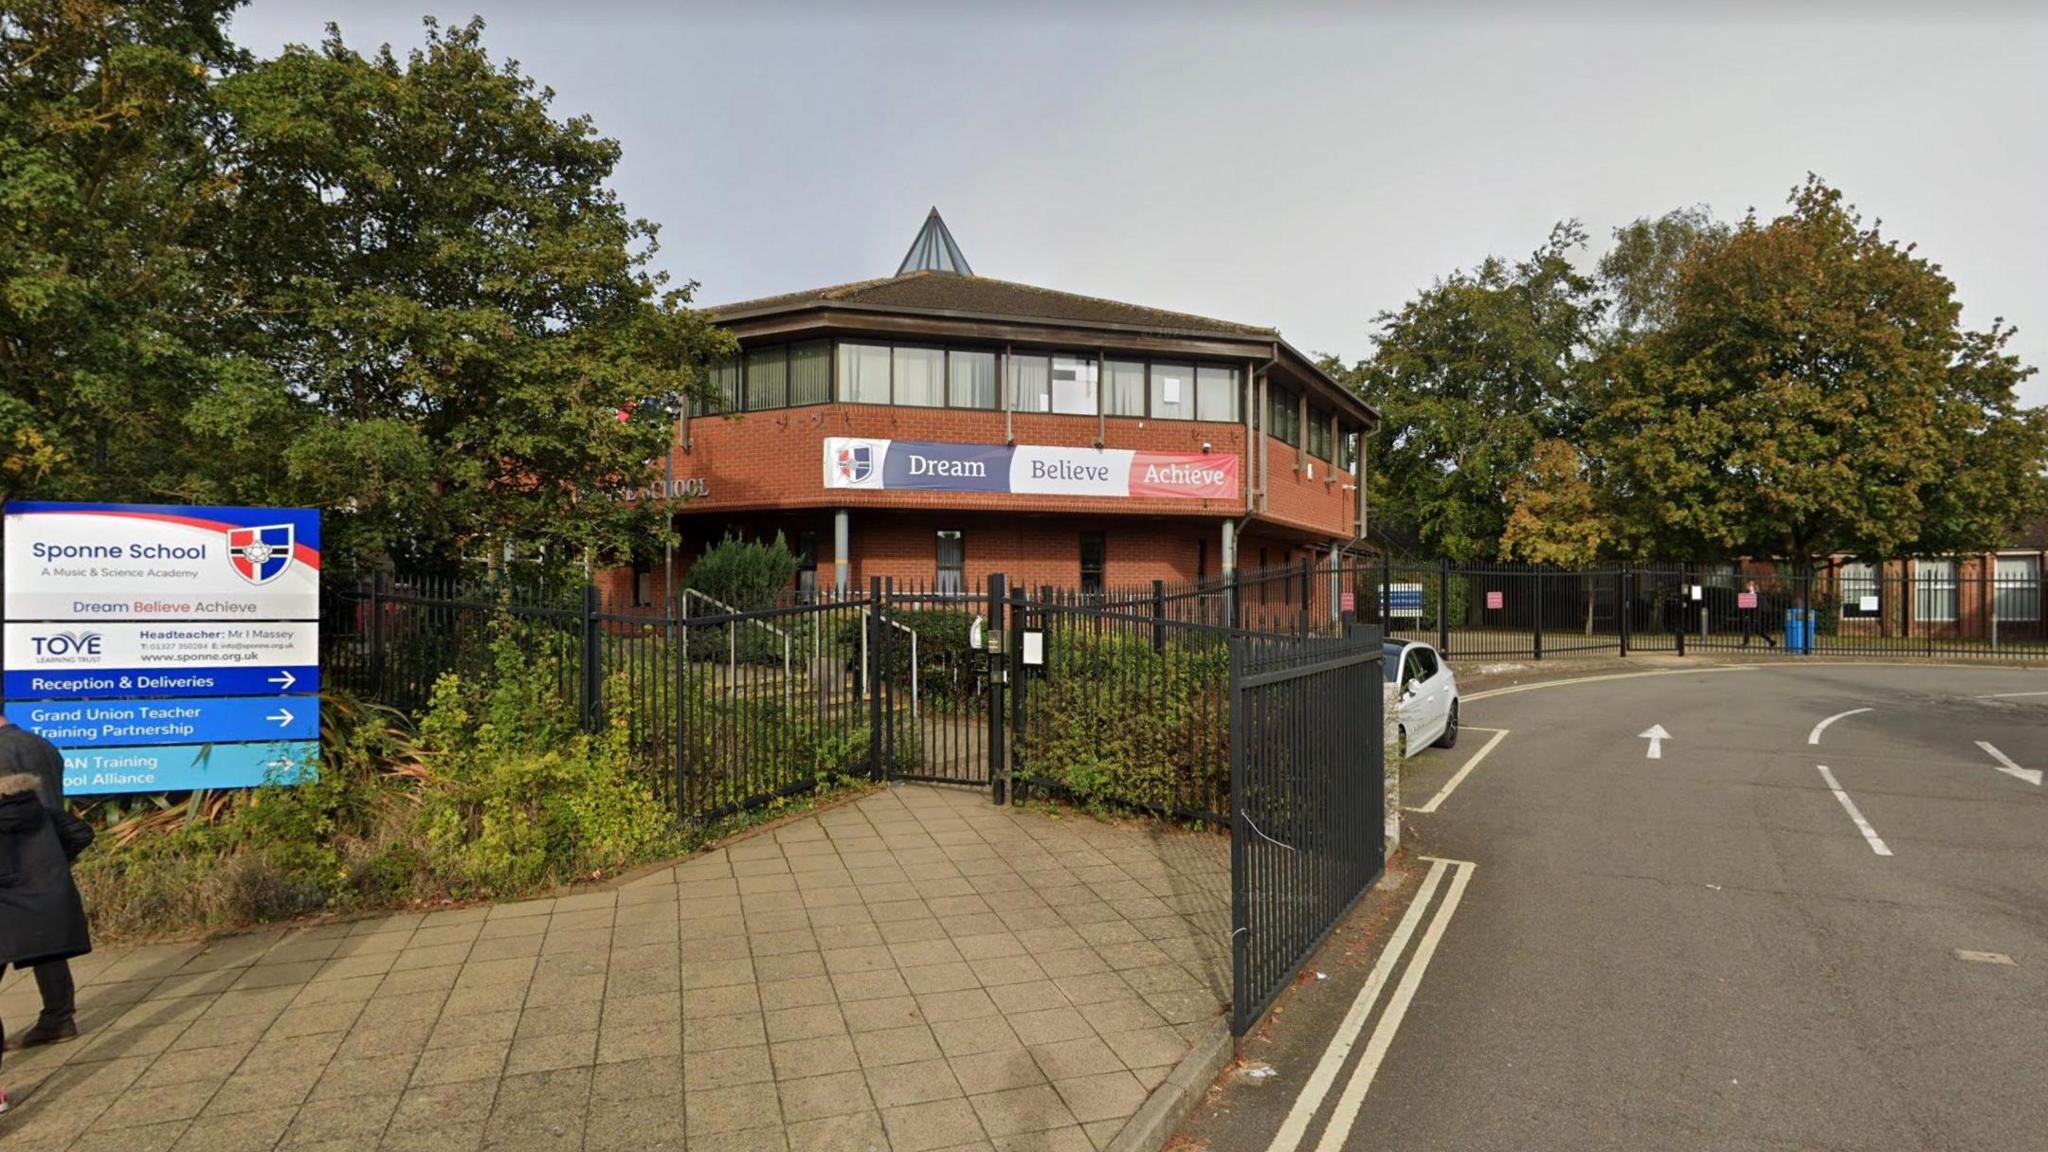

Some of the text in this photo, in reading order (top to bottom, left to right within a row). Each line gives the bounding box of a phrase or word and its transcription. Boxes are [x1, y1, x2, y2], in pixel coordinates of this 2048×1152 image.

[909, 454, 1225, 485] Dream Believe Achieve
[32, 542, 206, 563] Sponne School
[41, 567, 199, 579] A Music & Science Academy
[73, 601, 257, 613] Dream Believe Achieve
[140, 630, 225, 640] Headteacher:
[228, 630, 242, 639] Mr
[252, 629, 294, 640] Massey
[31, 632, 102, 655] TOVE
[78, 655, 101, 663] TRUST
[140, 651, 259, 662] www.sponne.org.uk
[32, 675, 215, 691] Reception & Deliveries
[31, 706, 201, 722] Grand Union Teacher
[31, 723, 194, 740] Training Partnership
[93, 755, 158, 770] Training
[92, 773, 155, 785] Alliance
